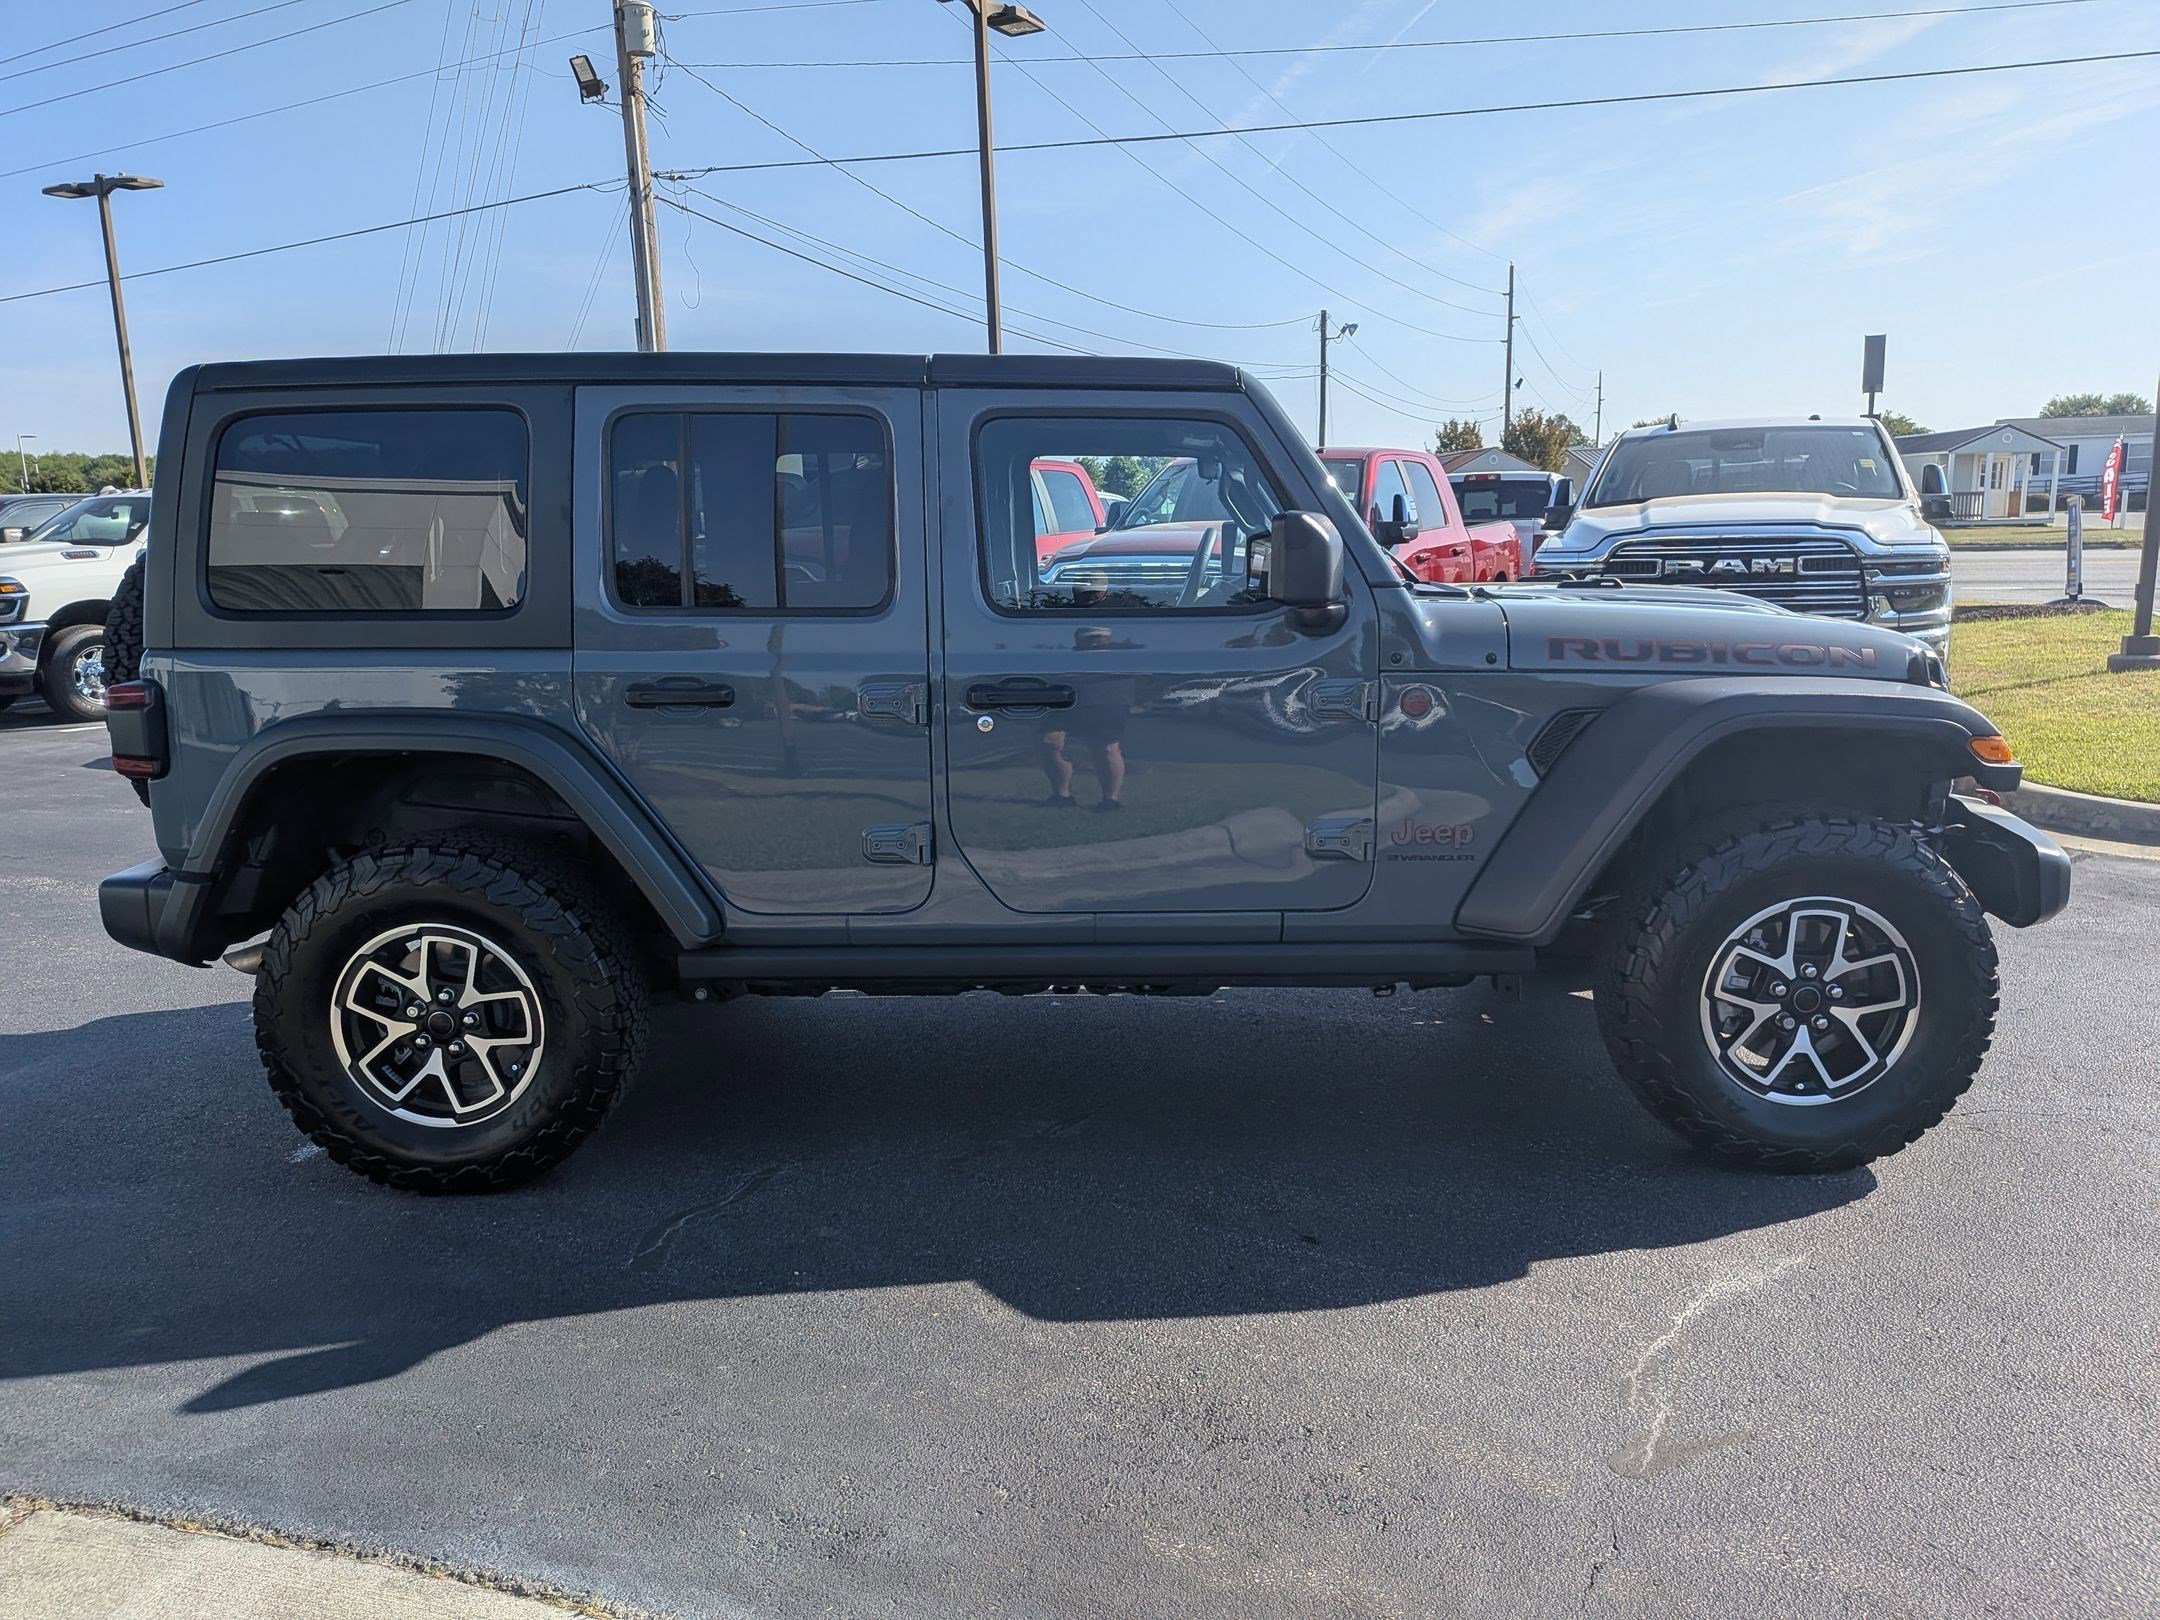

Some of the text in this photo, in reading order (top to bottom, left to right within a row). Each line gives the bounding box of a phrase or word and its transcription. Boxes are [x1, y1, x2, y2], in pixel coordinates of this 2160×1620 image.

[1664, 558, 1795, 575] RAM
[1546, 635, 1879, 669] RUBICON
[1391, 817, 1475, 849] Jeep
[1399, 854, 1475, 862] WRANGLER
